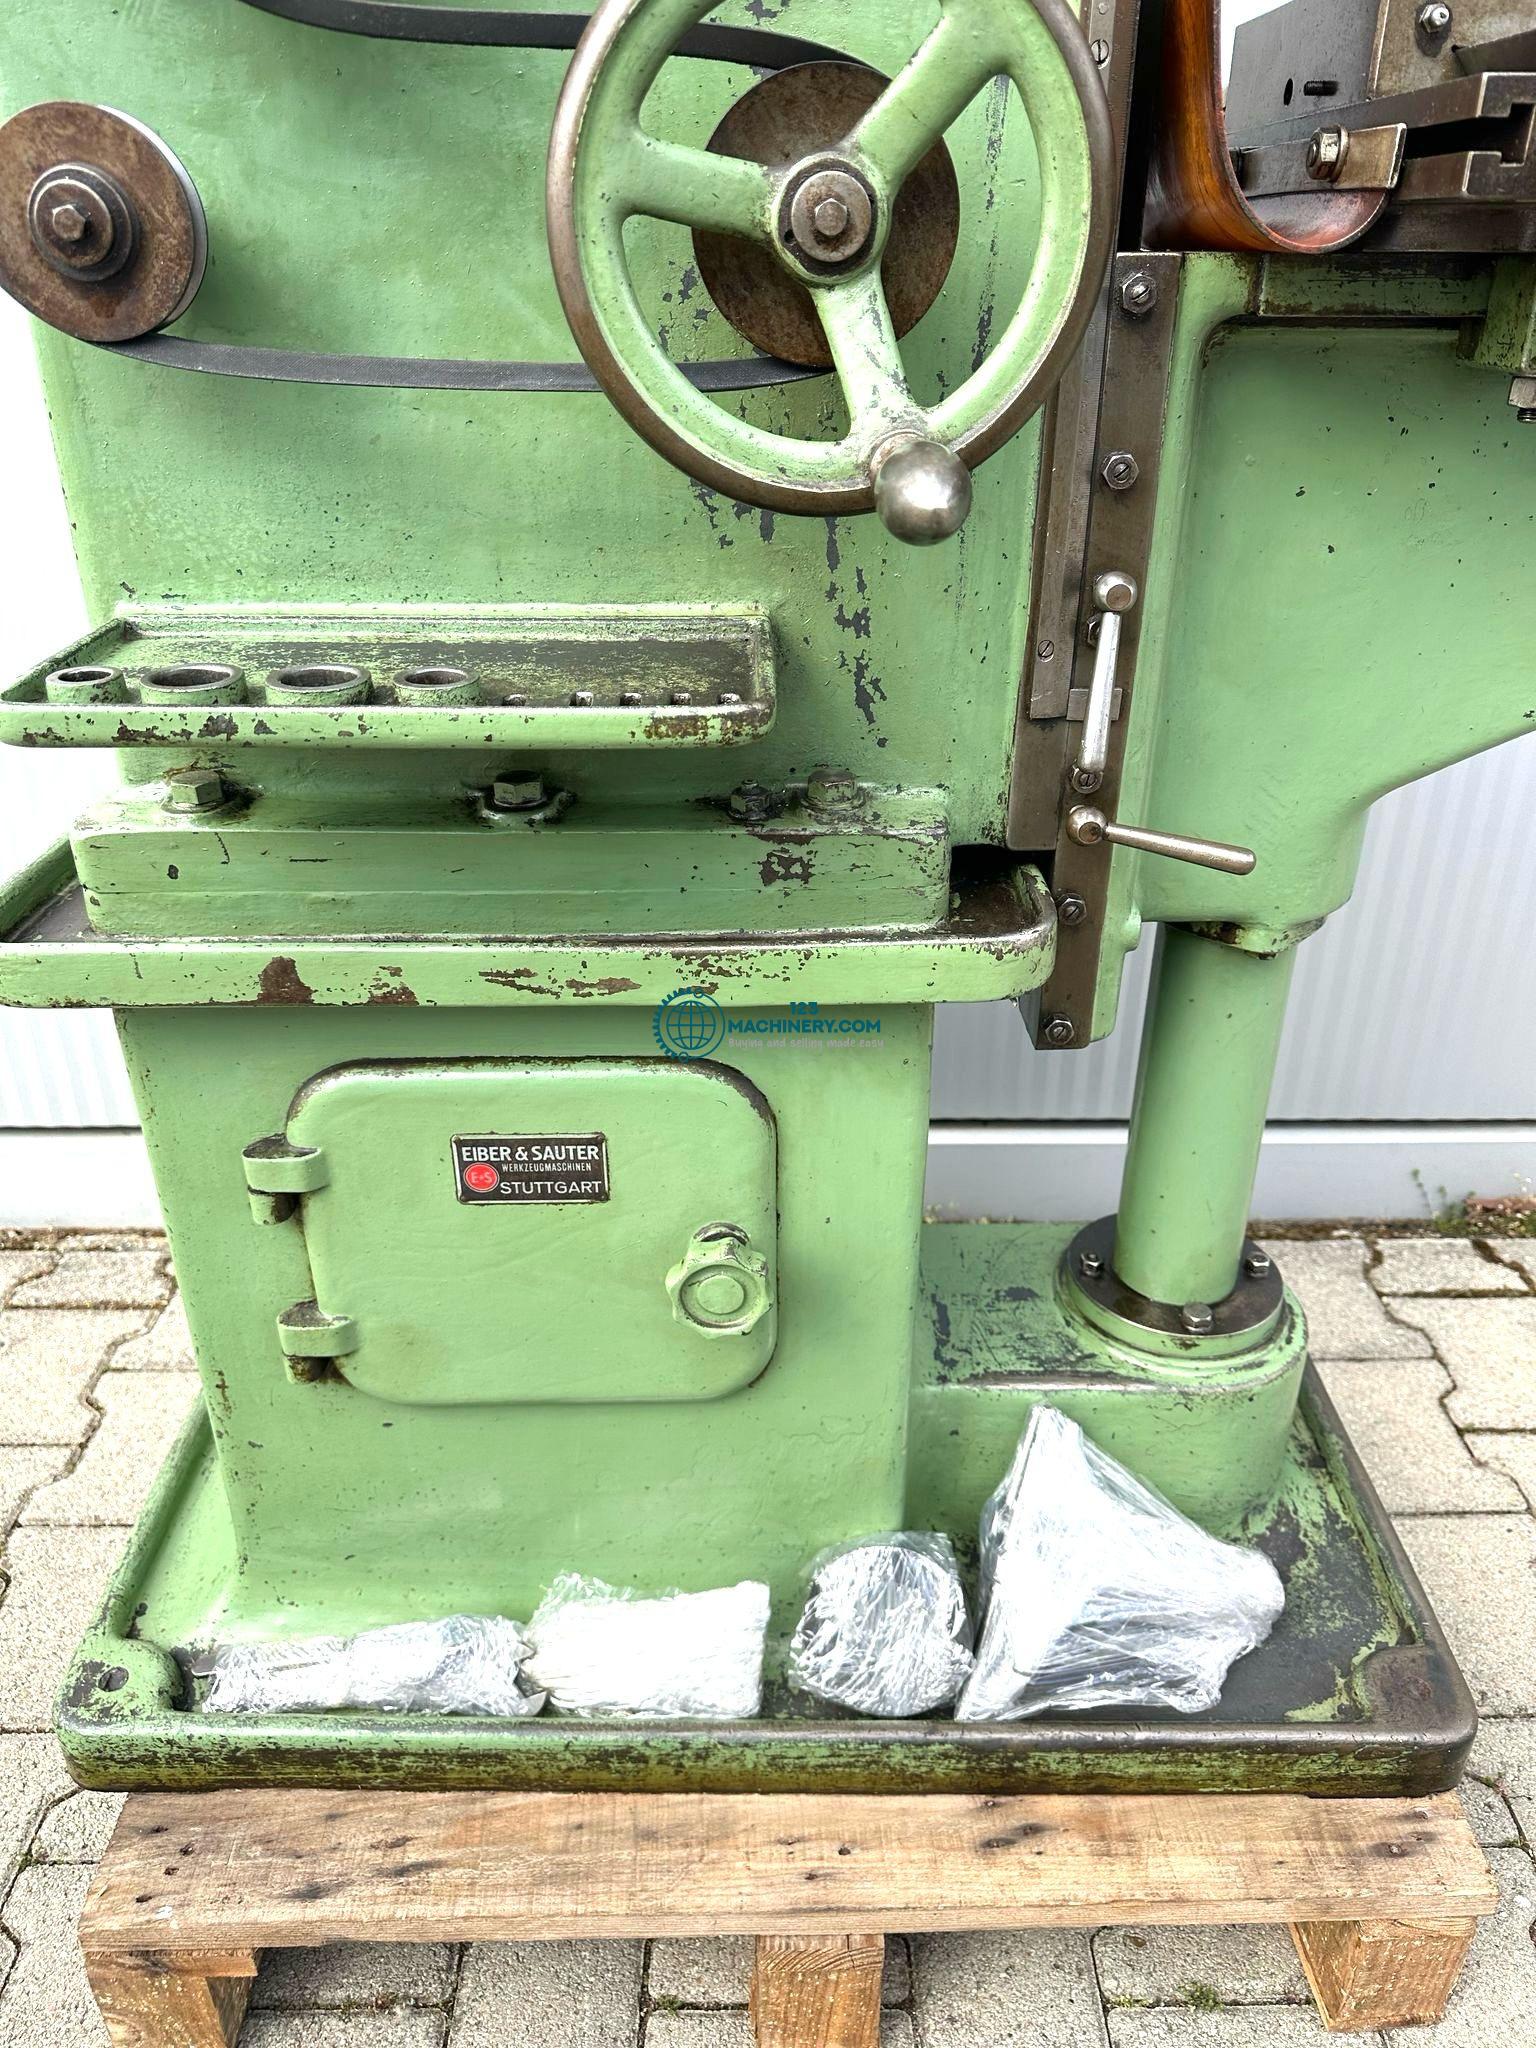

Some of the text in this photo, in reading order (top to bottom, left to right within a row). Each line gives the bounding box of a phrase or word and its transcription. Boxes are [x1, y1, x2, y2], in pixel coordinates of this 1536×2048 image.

[461, 1145, 600, 1161] EIBER & SAUTER
[501, 1162, 592, 1172] WERKZEUGMASCHINEN
[500, 1180, 602, 1194] STUTTGART
